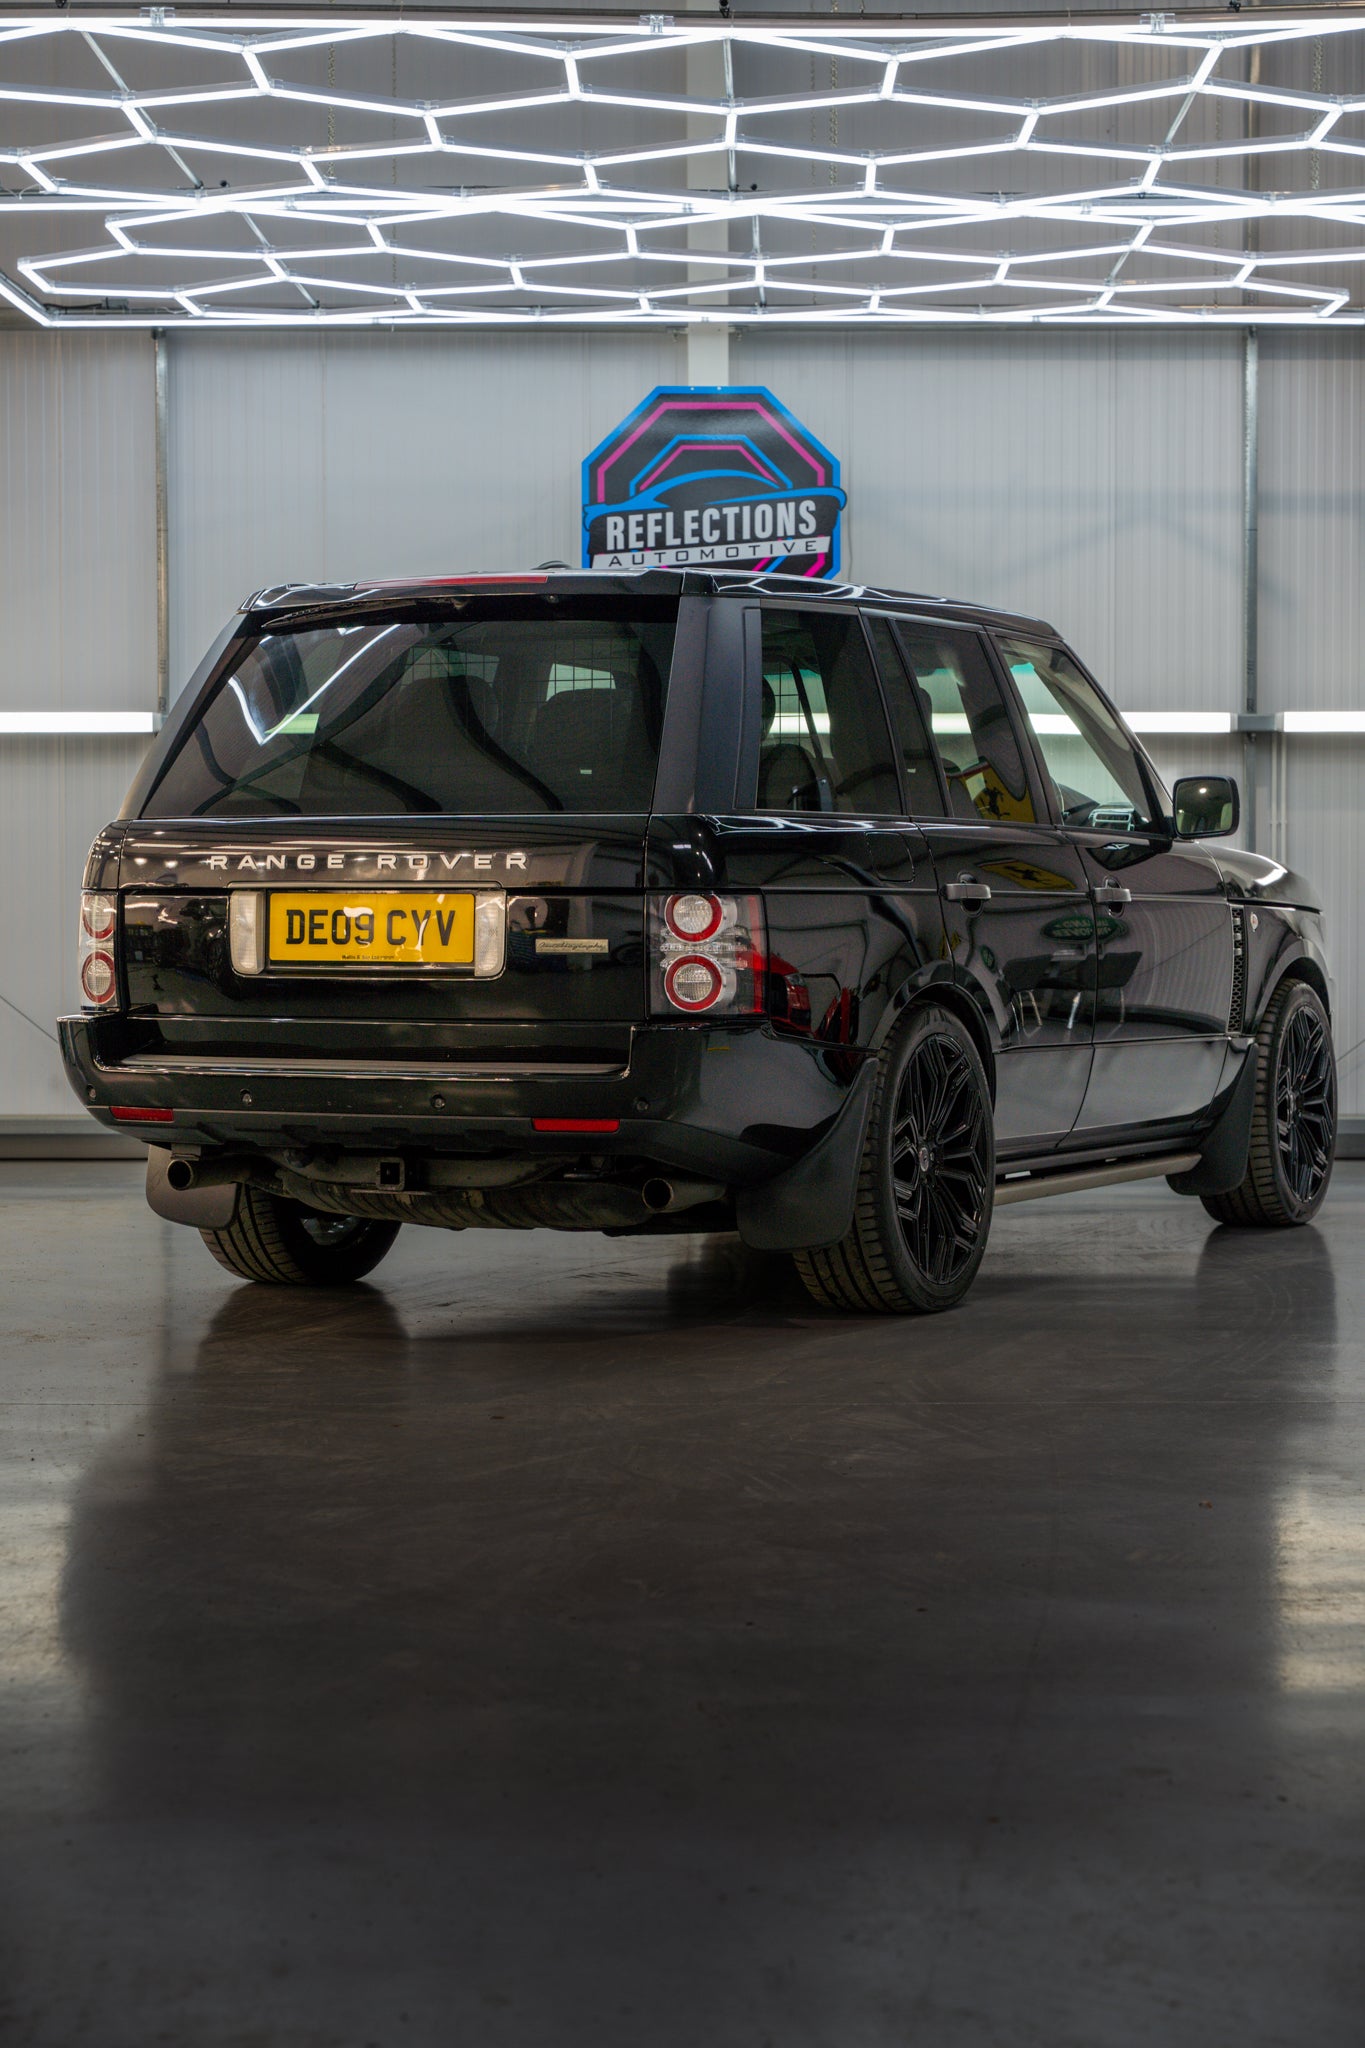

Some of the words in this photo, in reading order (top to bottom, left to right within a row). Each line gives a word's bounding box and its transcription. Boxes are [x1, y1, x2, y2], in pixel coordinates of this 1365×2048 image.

[606, 500, 817, 551] REFLECTIONS
[608, 541, 817, 567] AUTOMOTIVE
[210, 854, 345, 870] RANGE
[377, 854, 528, 870] ROVER
[286, 909, 375, 946] DE09
[387, 910, 456, 946] CYV
